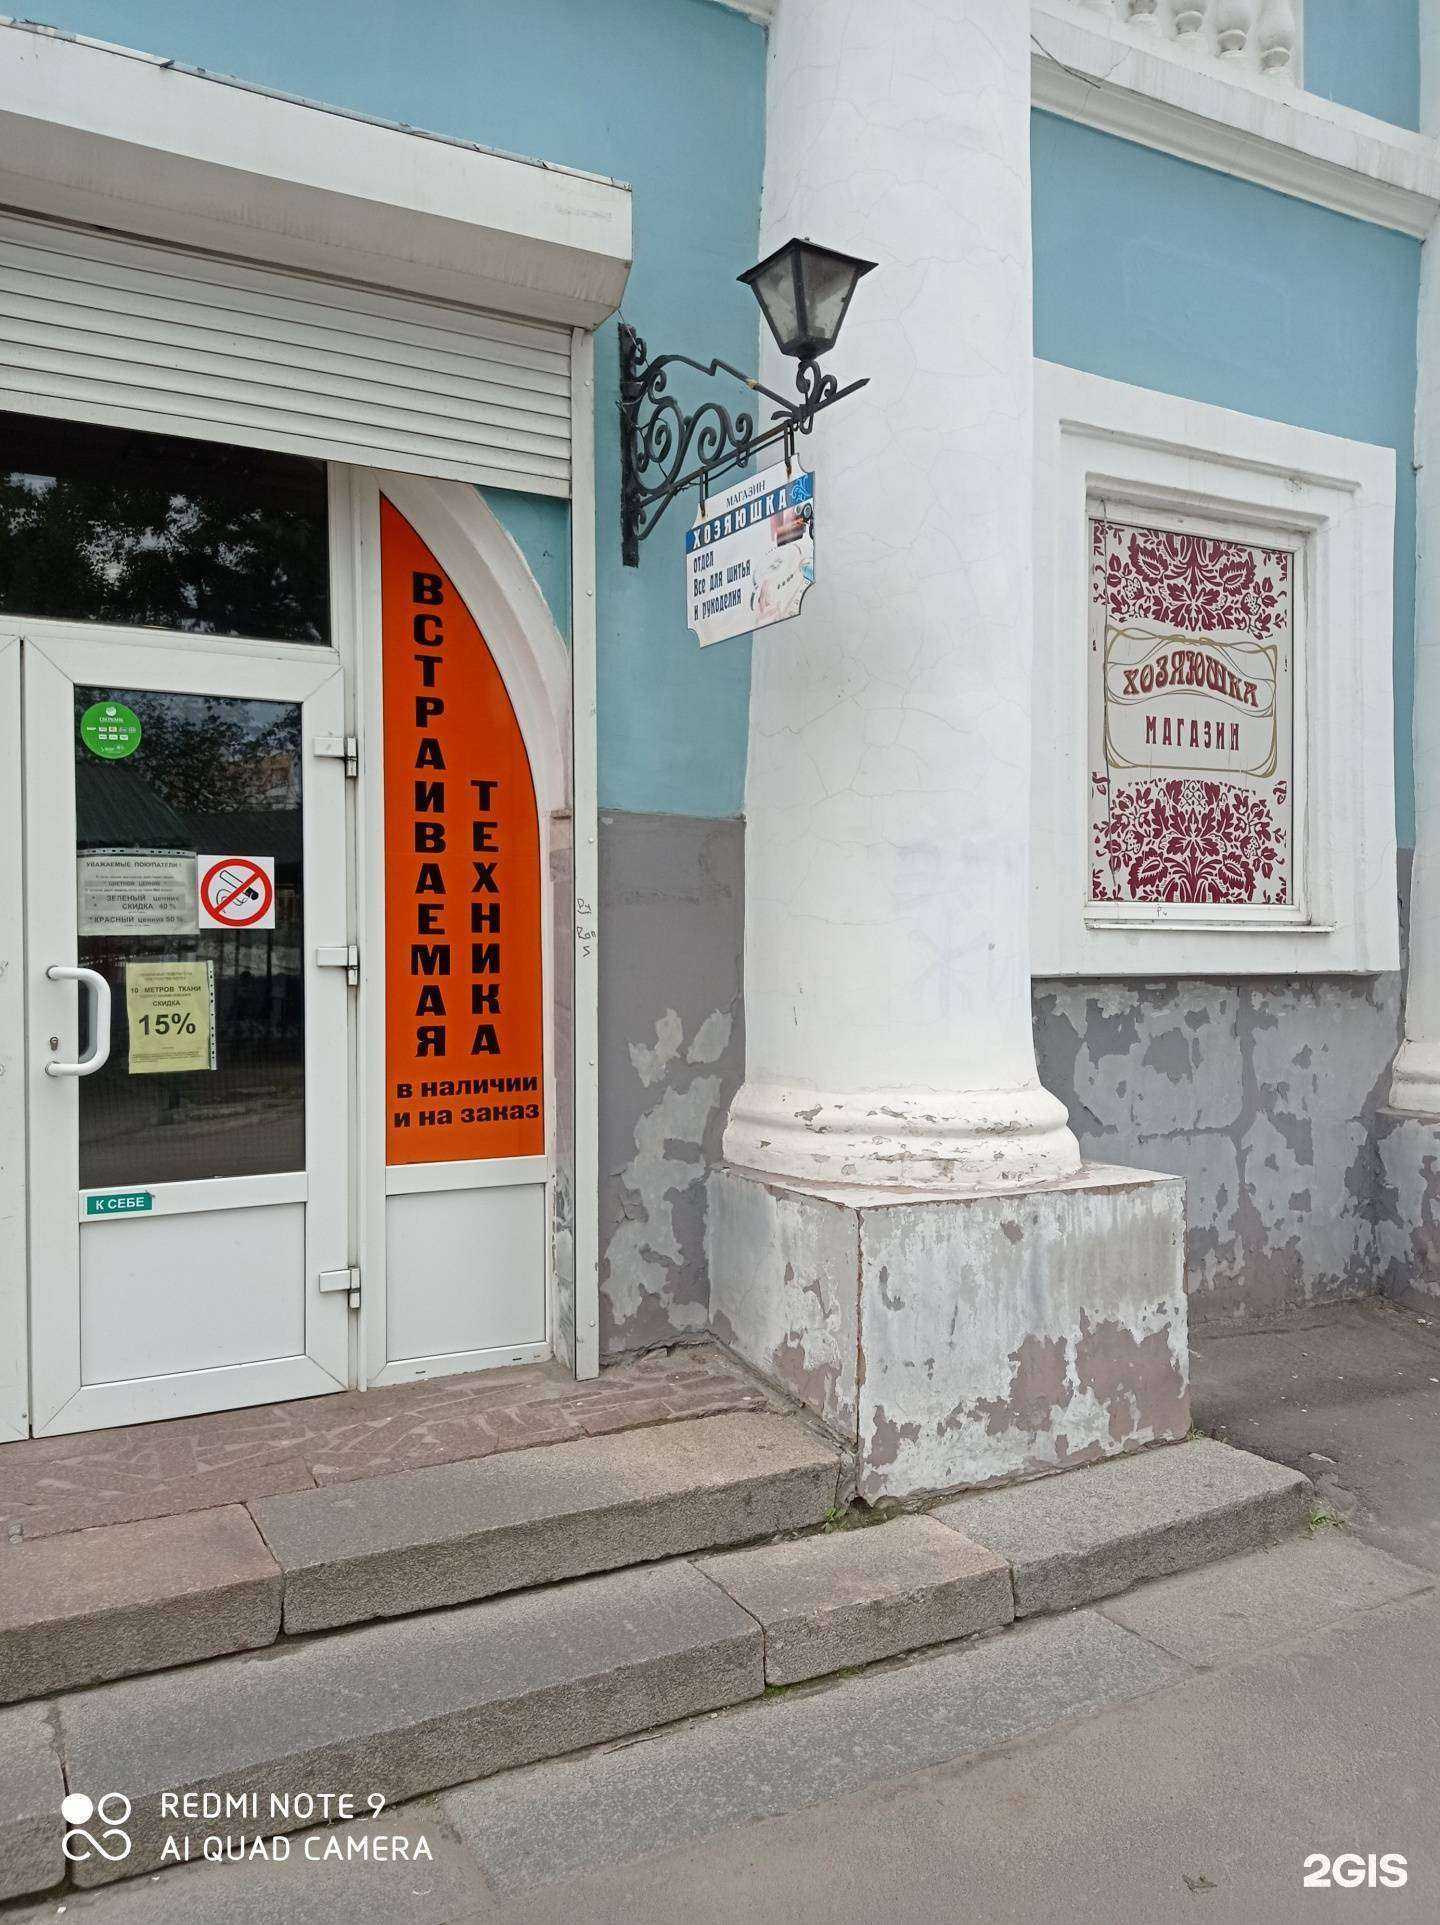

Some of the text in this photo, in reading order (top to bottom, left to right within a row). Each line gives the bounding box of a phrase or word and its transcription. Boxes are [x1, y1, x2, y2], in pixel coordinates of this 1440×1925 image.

[726, 480, 767, 508] МАГАЗИН
[693, 489, 788, 550] ХОЗЯЮШКА
[693, 559, 751, 597] Все для шитья
[702, 588, 742, 619] рукоделия
[1122, 649, 1260, 709] ХОЗЯЮШКА
[1145, 715, 1241, 752] МАГАЗИН
[411, 571, 451, 1057] ВСТРАИВАЕМАЯ
[470, 779, 502, 1056] ТЕХНИКА
[152, 999, 181, 1007] СКИДКА
[138, 1012, 196, 1035] 15%
[396, 1076, 538, 1099] в наличии
[394, 1103, 540, 1128] и на заказ
[96, 1197, 145, 1210] К СЕБЕ
